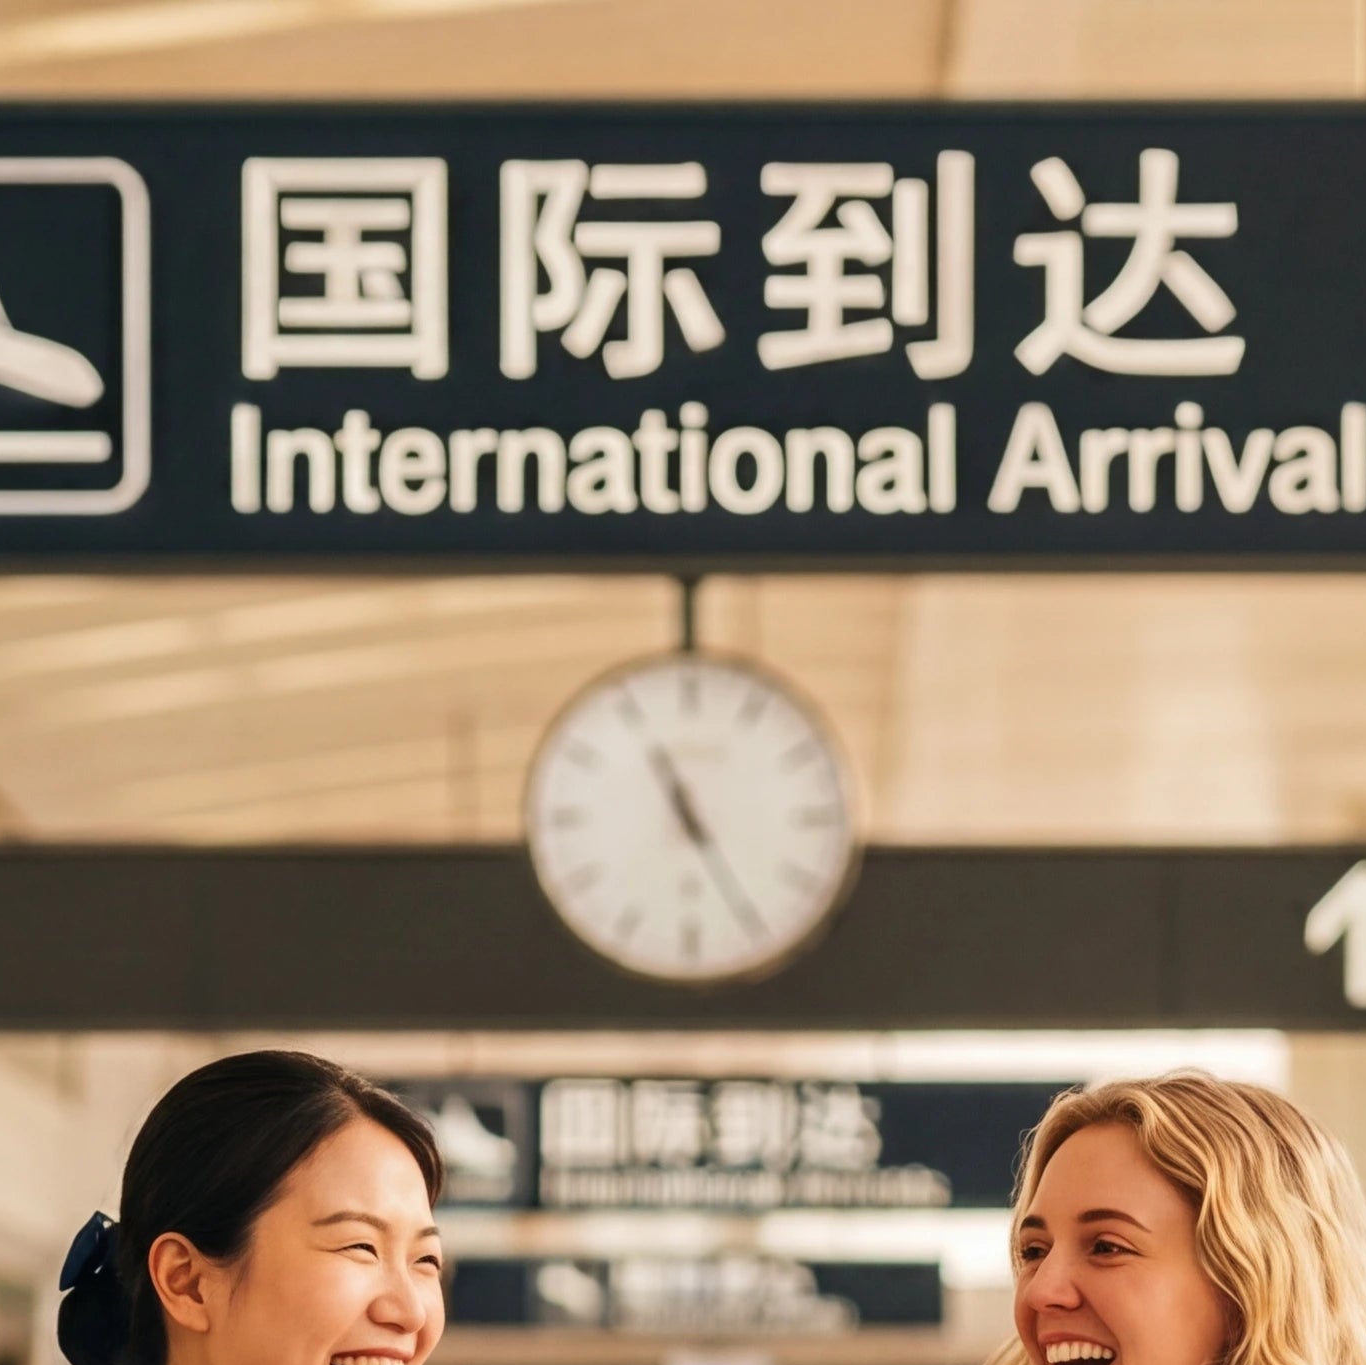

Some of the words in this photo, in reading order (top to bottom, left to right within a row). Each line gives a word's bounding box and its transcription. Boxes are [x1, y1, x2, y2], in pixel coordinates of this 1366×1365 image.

[241, 148, 1246, 381] 国际到达
[230, 402, 957, 515] International
